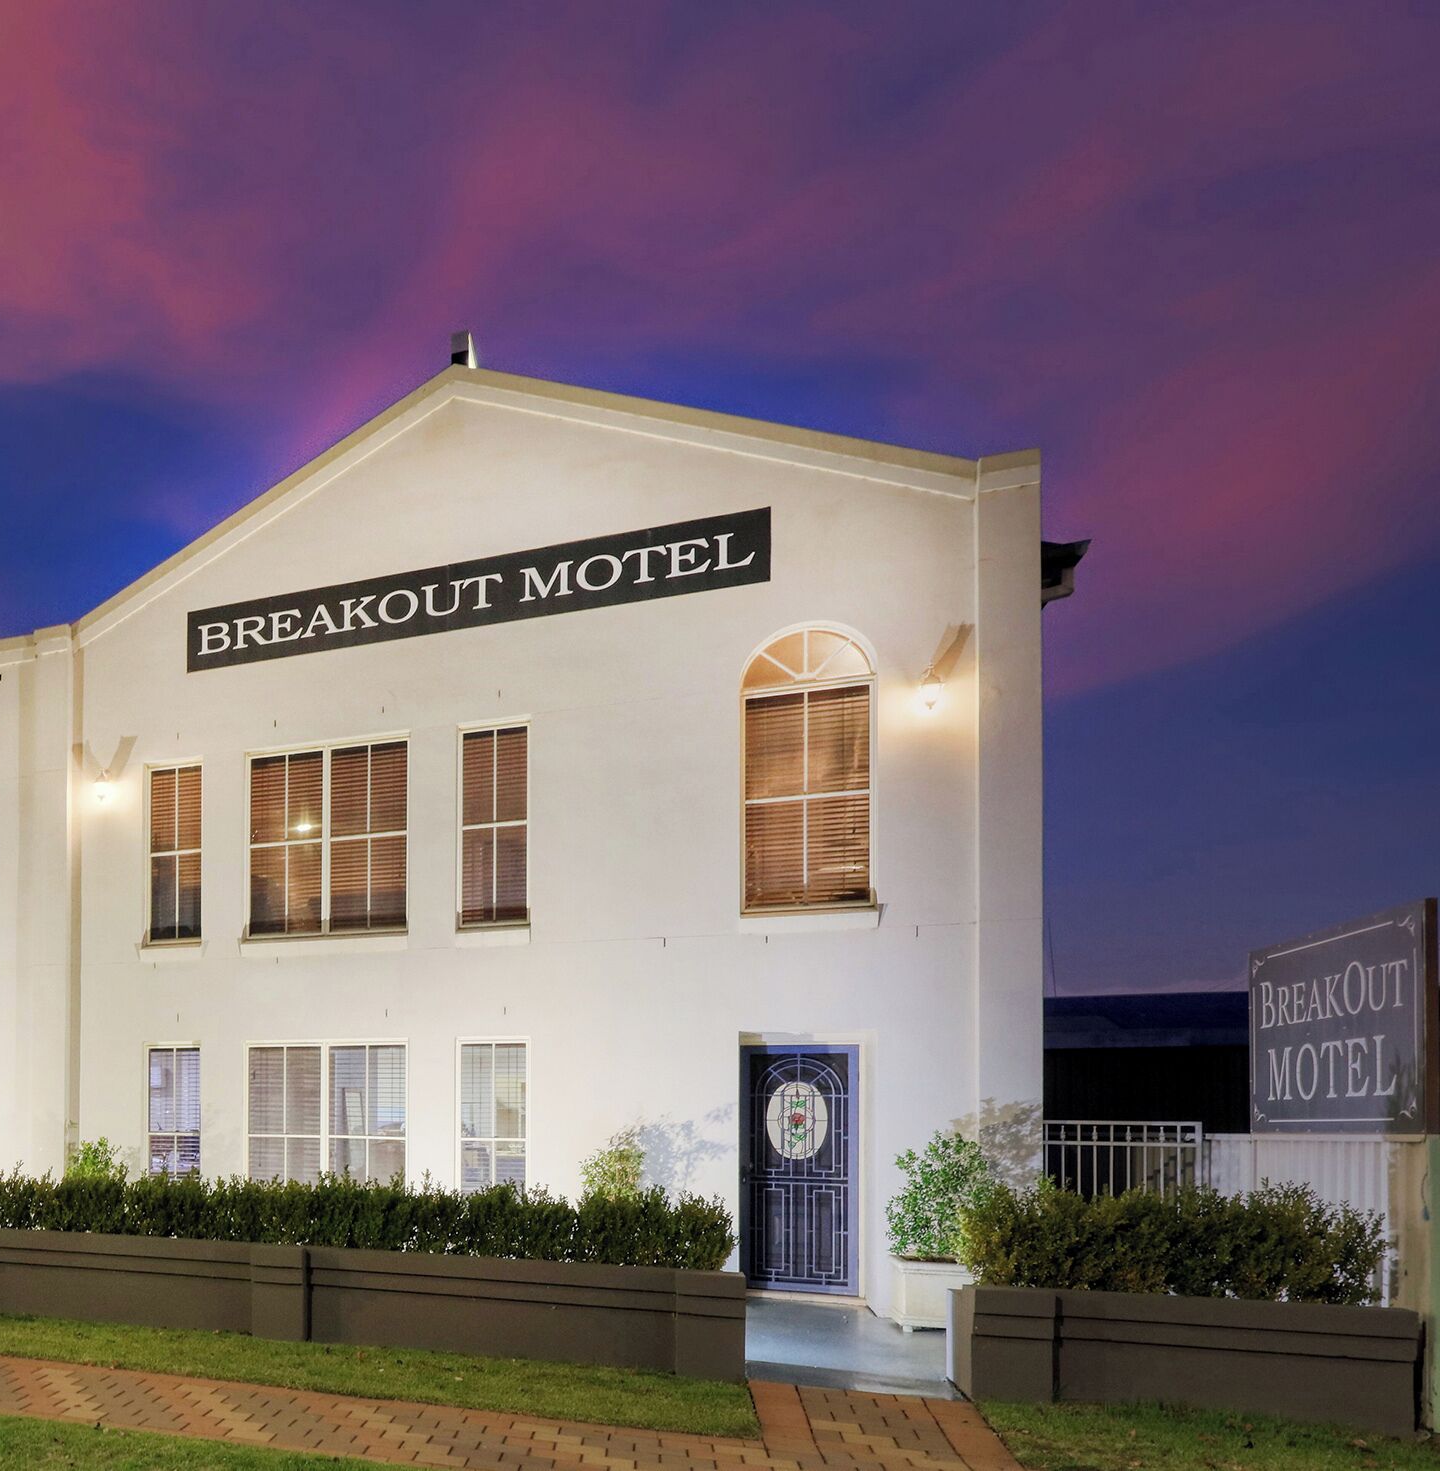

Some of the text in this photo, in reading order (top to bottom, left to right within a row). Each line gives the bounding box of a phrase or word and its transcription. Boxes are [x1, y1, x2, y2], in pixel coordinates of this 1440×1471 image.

[197, 532, 756, 655] BREAKOUT MOTEL
[1260, 959, 1408, 1029] BREAKOUT
[1268, 1035, 1397, 1101] MOTEL
